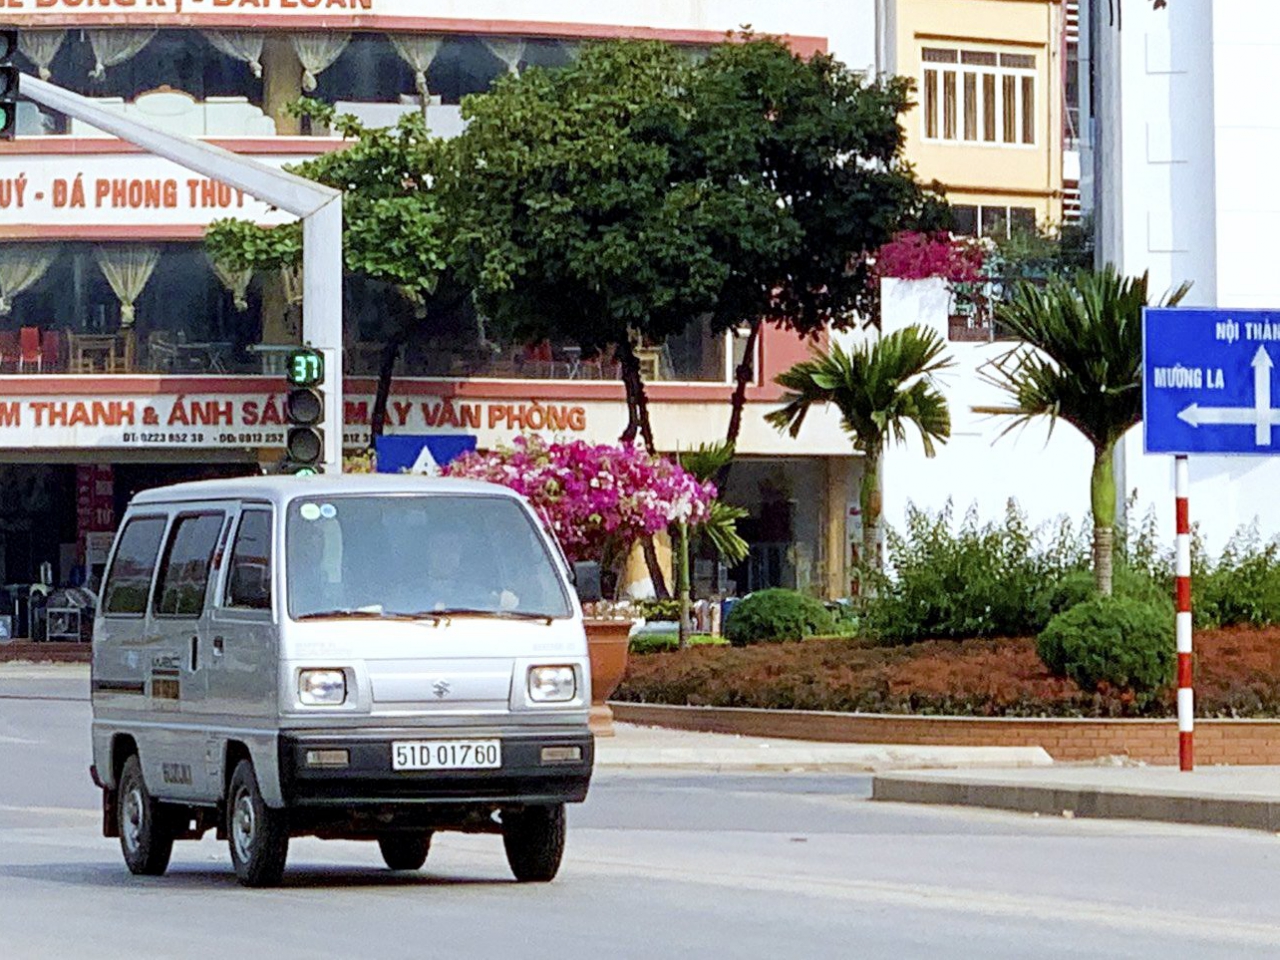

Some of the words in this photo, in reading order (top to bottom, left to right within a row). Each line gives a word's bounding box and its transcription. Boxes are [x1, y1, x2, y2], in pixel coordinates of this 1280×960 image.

[51, 172, 86, 209] ĐÁ
[94, 178, 178, 209] PHONG
[1215, 318, 1240, 344] NỘI
[293, 355, 319, 382] 37
[1153, 361, 1203, 389] MƯỜNG
[1206, 368, 1225, 389] LA
[29, 401, 136, 429] THANH
[141, 405, 159, 426] &
[166, 394, 234, 426] ÁNH
[420, 395, 482, 430] VĂN
[487, 399, 587, 431] PHÒNG
